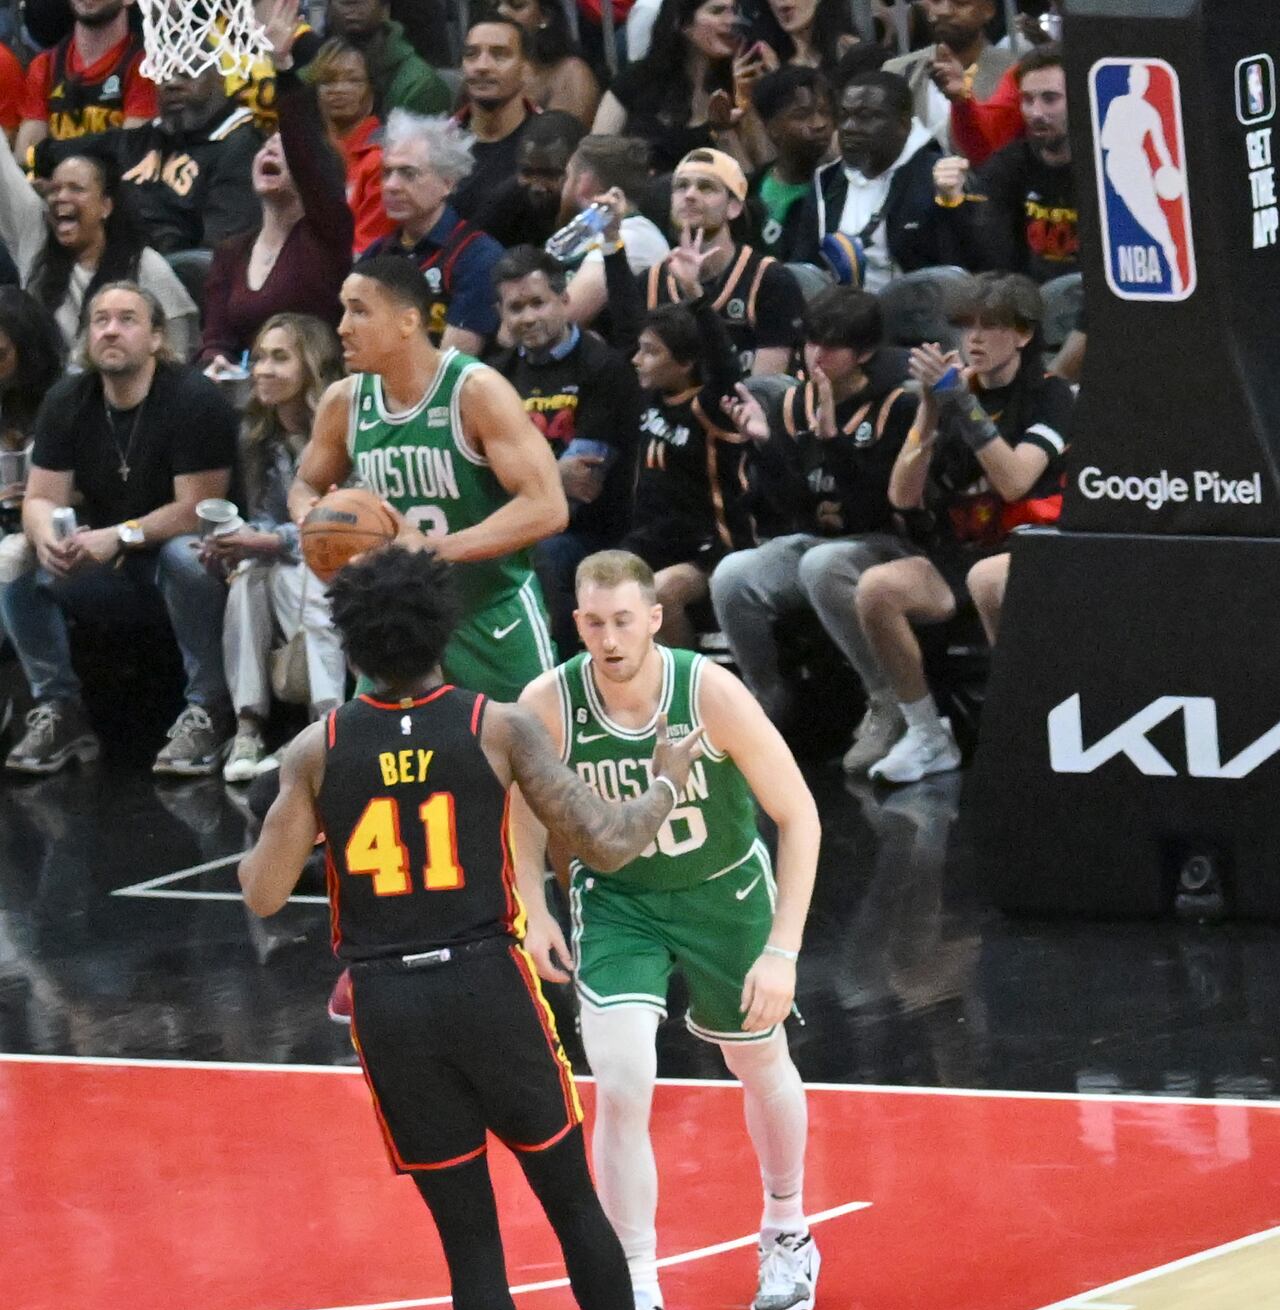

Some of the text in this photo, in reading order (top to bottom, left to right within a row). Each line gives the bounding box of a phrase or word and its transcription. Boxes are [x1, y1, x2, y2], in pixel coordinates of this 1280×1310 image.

[1246, 127, 1272, 170] GET
[1249, 167, 1277, 209] THE
[1253, 206, 1279, 250] APP
[1118, 244, 1163, 283] NBA
[357, 446, 461, 500] BOSTON
[1078, 466, 1262, 510] Google Pixel
[577, 707, 588, 724] 6
[379, 749, 434, 786] BEY
[576, 758, 709, 803] BOSTN
[344, 791, 466, 896] 41
